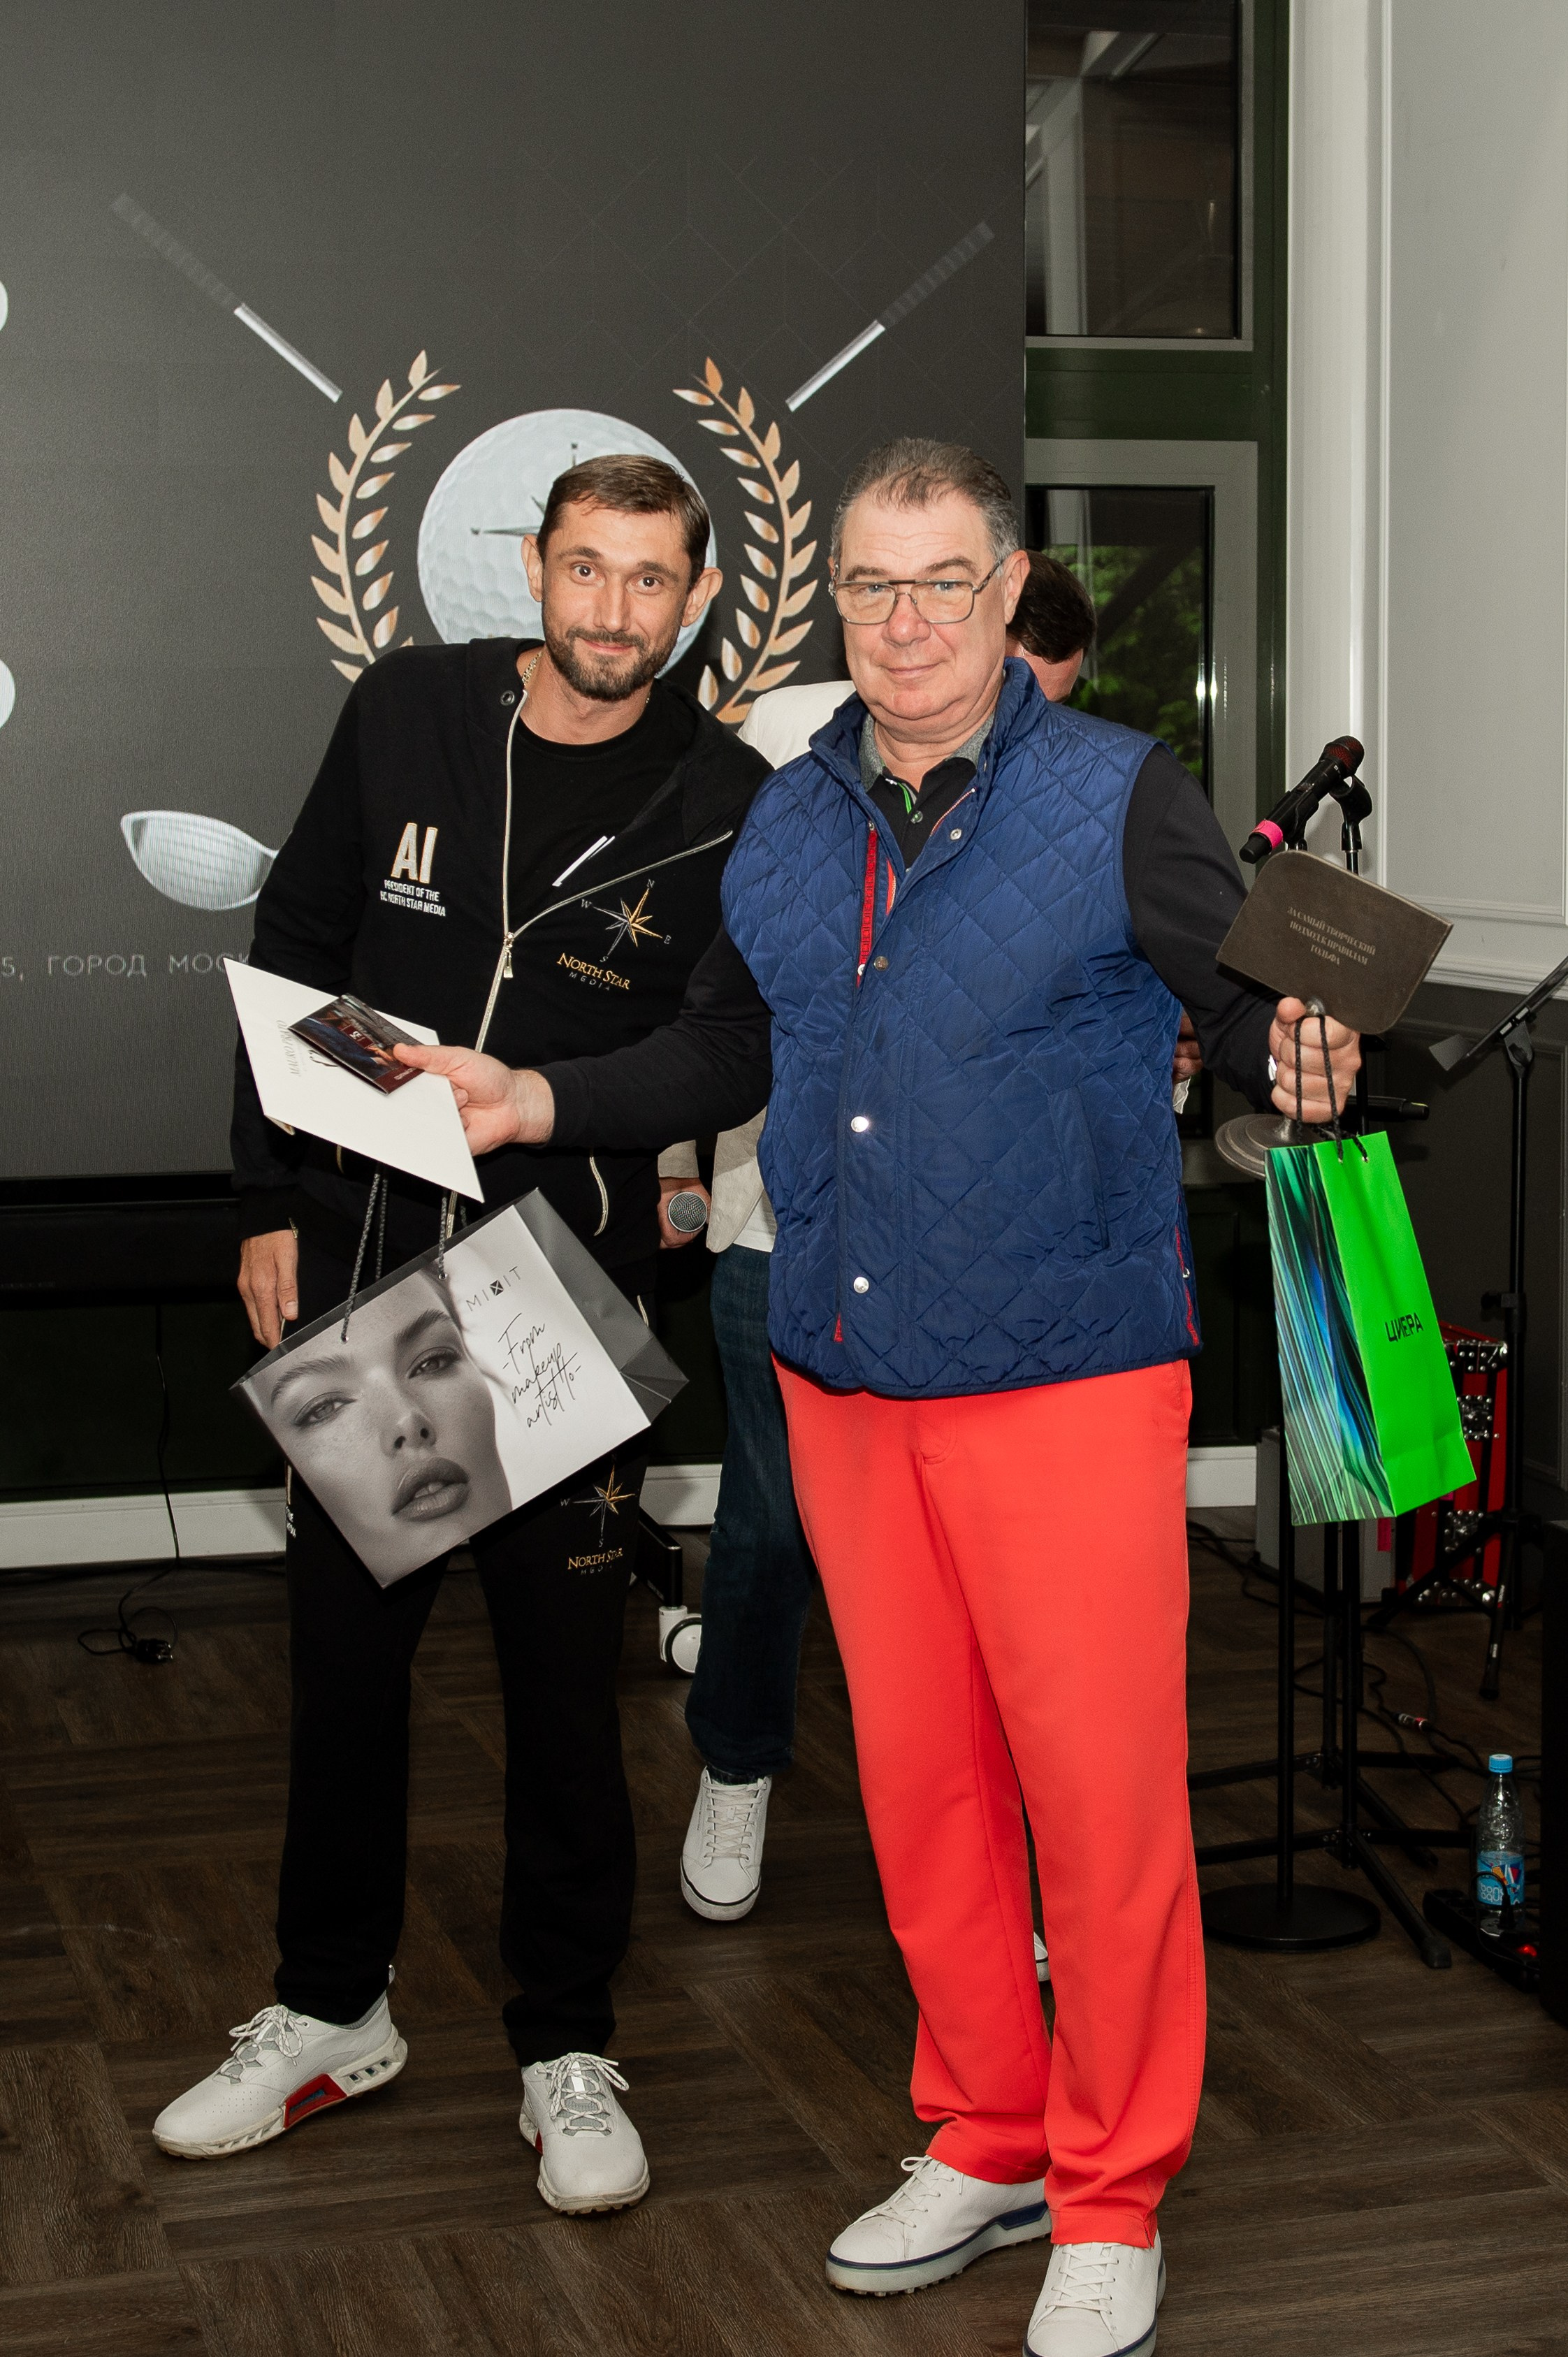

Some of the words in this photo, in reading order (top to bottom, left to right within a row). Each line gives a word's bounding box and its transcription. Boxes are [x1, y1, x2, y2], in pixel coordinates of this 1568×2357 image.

[391, 822, 438, 884] AI
[384, 879, 416, 896] PRESIDENT
[416, 887, 426, 898] OF
[425, 889, 440, 901] THE
[646, 878, 655, 888] N
[388, 894, 407, 906] NORTH
[406, 897, 423, 911] STAR
[423, 901, 446, 917] MEDIA
[664, 934, 672, 945] E
[48, 955, 147, 977] ГОРОД
[556, 952, 604, 978] NORTH
[569, 971, 611, 992] MEDIA
[567, 1553, 605, 1569] NORTH
